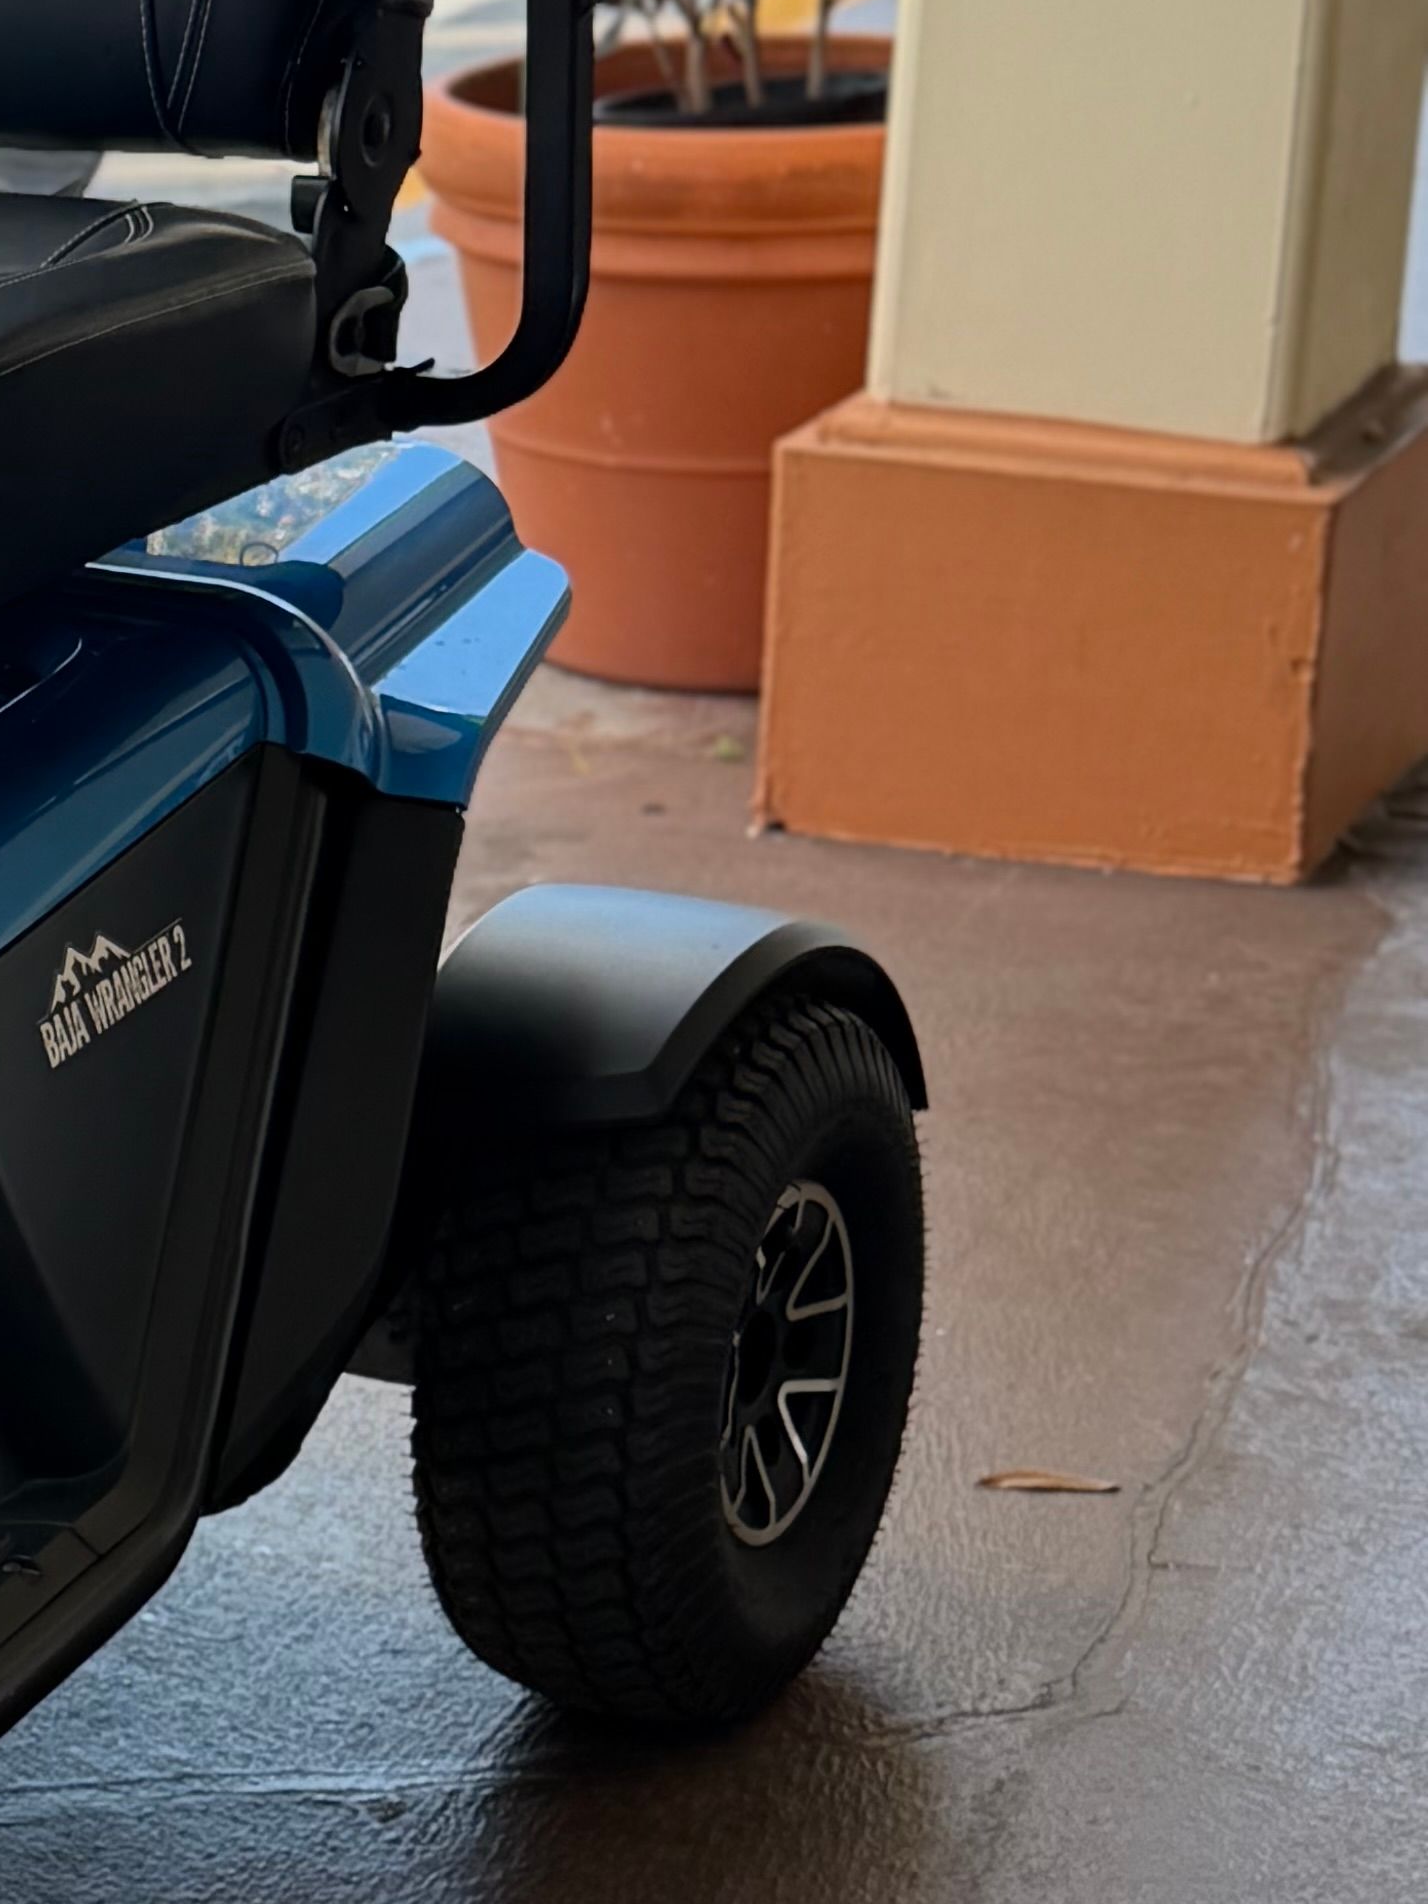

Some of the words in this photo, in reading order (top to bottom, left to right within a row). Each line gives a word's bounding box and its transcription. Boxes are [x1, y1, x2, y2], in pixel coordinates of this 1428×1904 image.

[40, 1001, 91, 1069] BAJA
[84, 936, 178, 1034] WRANGLER
[173, 925, 192, 971] 2
